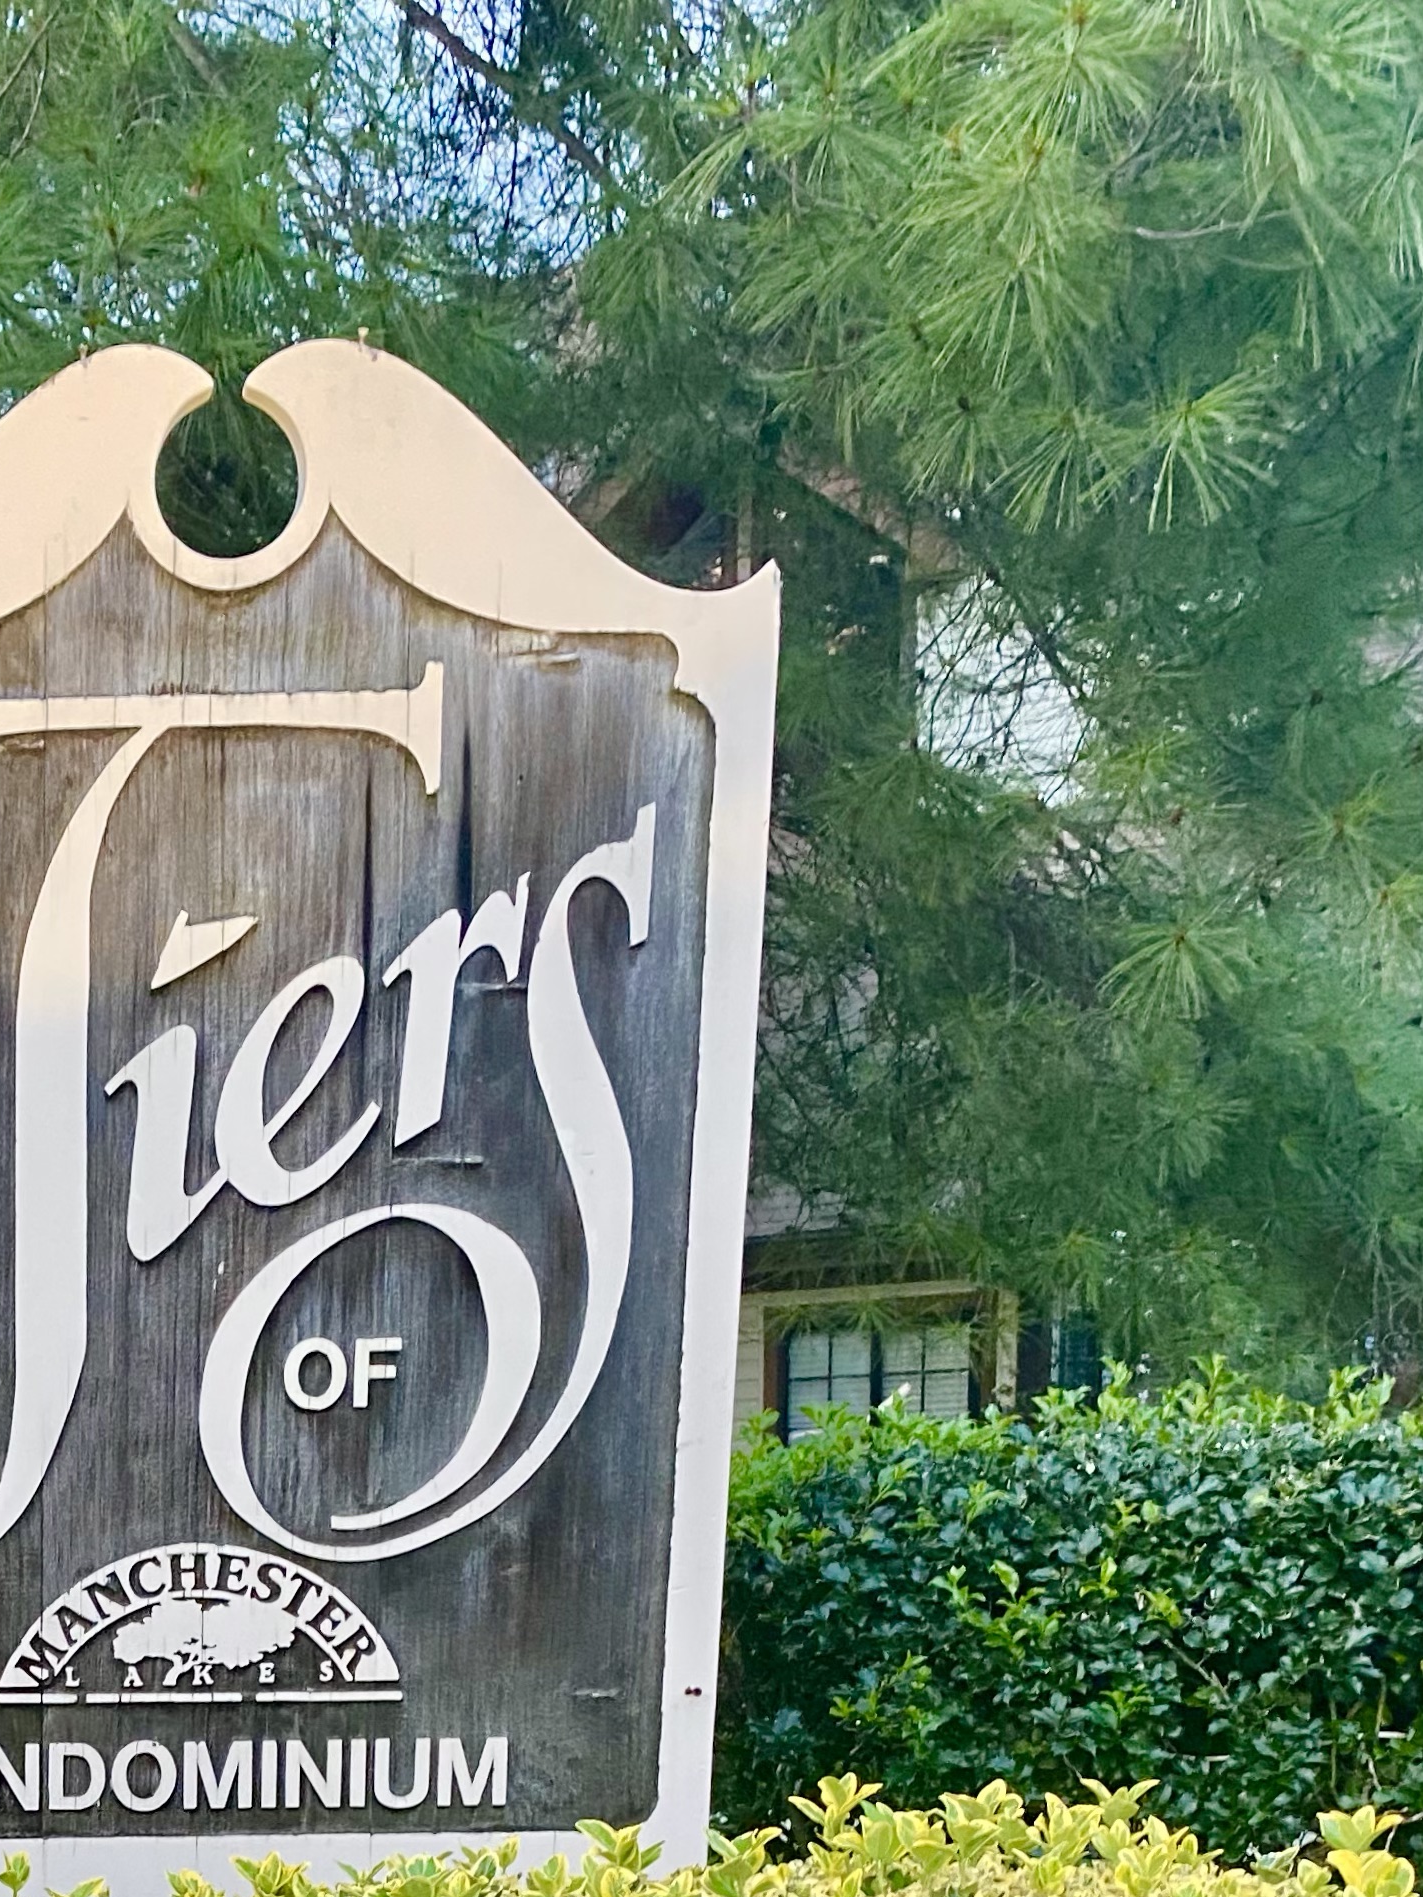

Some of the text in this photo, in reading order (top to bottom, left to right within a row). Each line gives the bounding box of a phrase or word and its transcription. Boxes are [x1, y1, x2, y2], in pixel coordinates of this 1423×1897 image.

[282, 1336, 403, 1412] OF
[14, 1552, 377, 1684] MANCHESTER
[64, 1660, 334, 1687] LAKES
